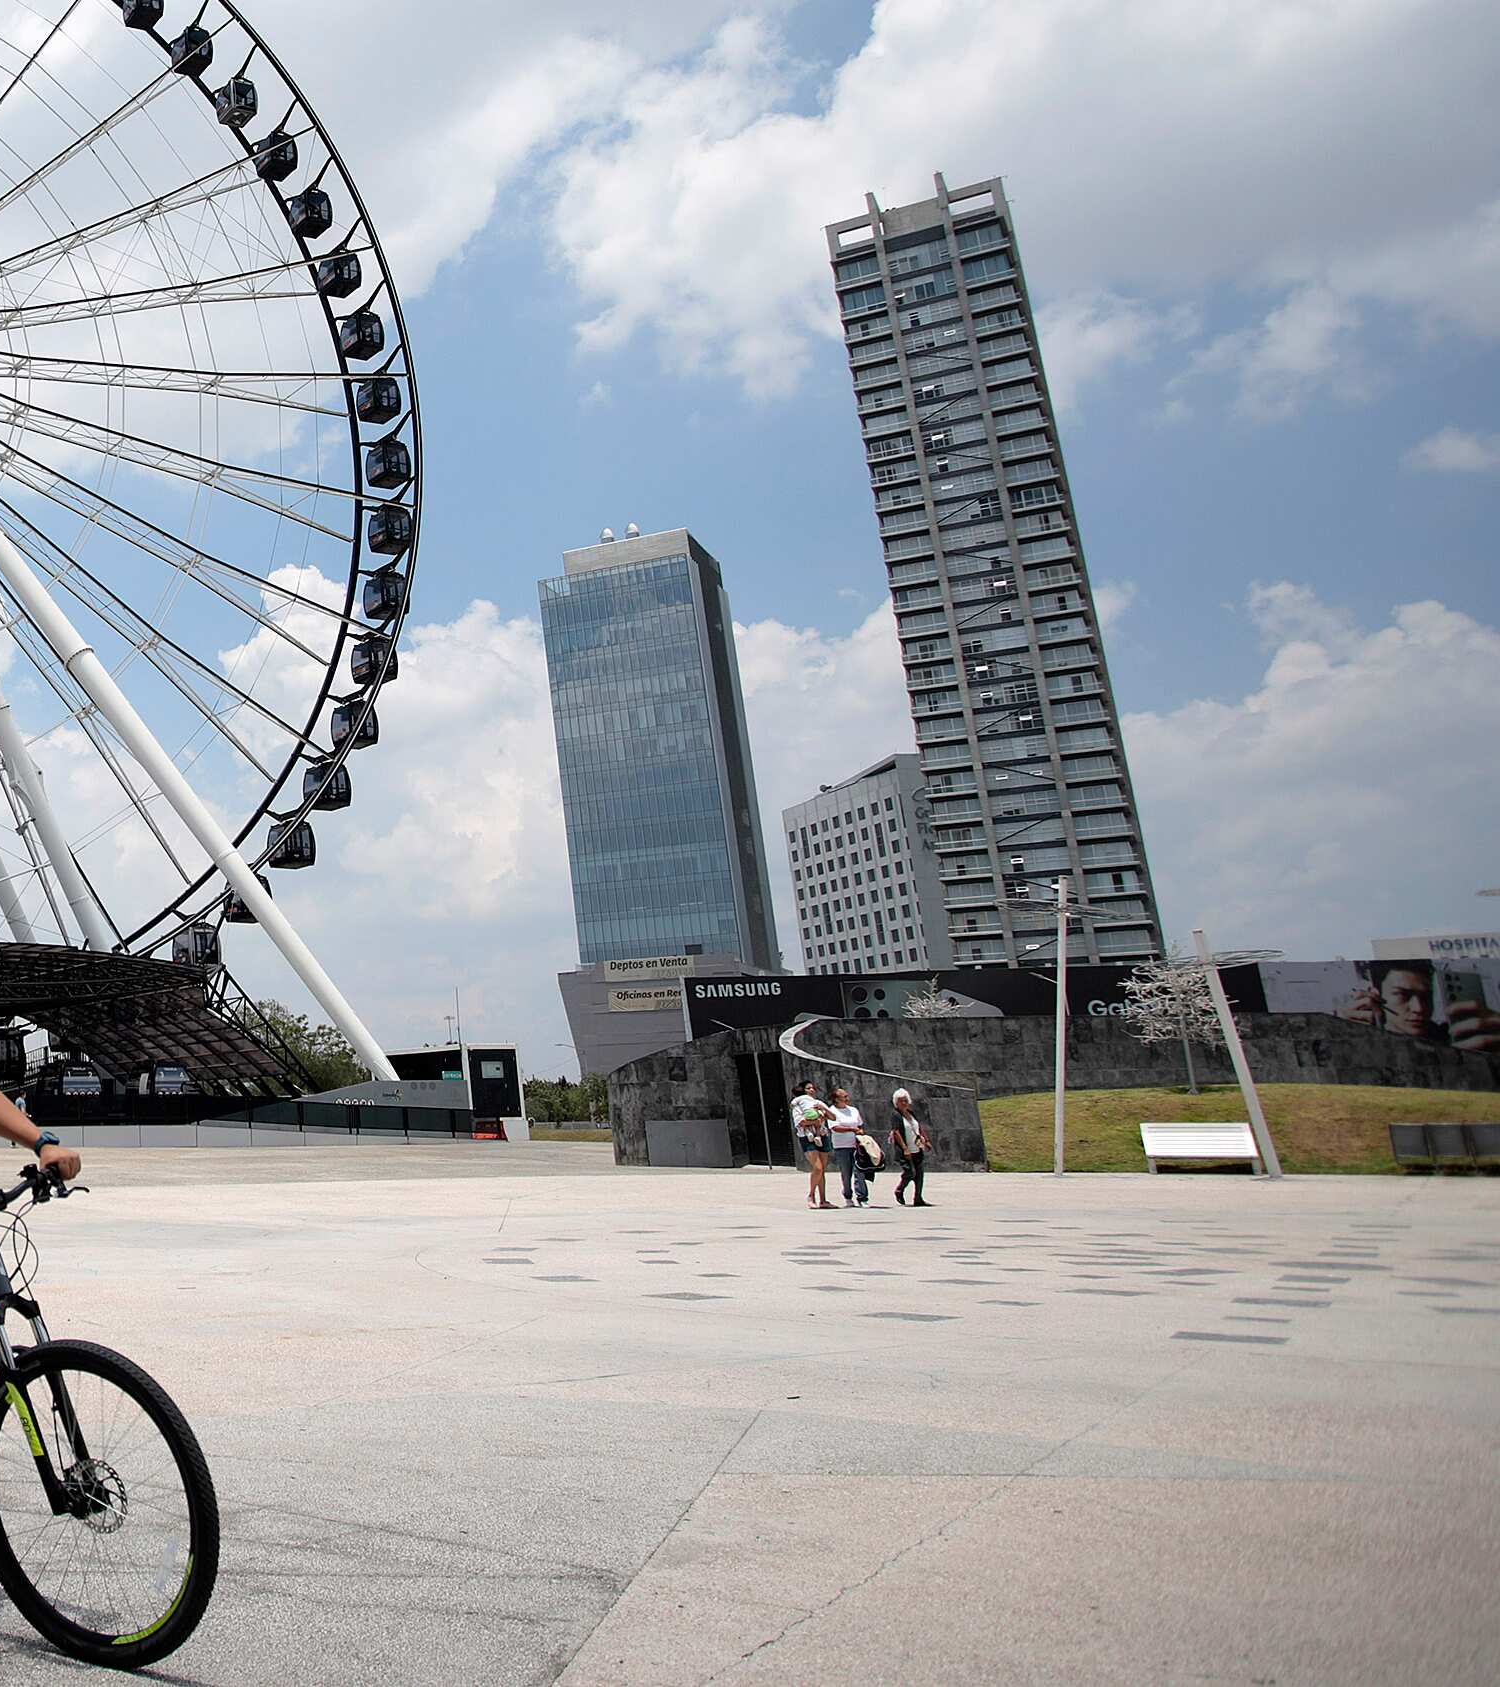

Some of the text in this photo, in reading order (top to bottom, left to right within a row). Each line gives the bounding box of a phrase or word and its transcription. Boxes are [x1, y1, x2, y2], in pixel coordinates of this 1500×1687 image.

[1428, 937, 1500, 951] HOSPITA
[610, 957, 688, 972] Deptos en Venta
[616, 990, 652, 1001] Oficinas
[654, 990, 665, 999] en
[695, 982, 781, 998] SAMSUNG
